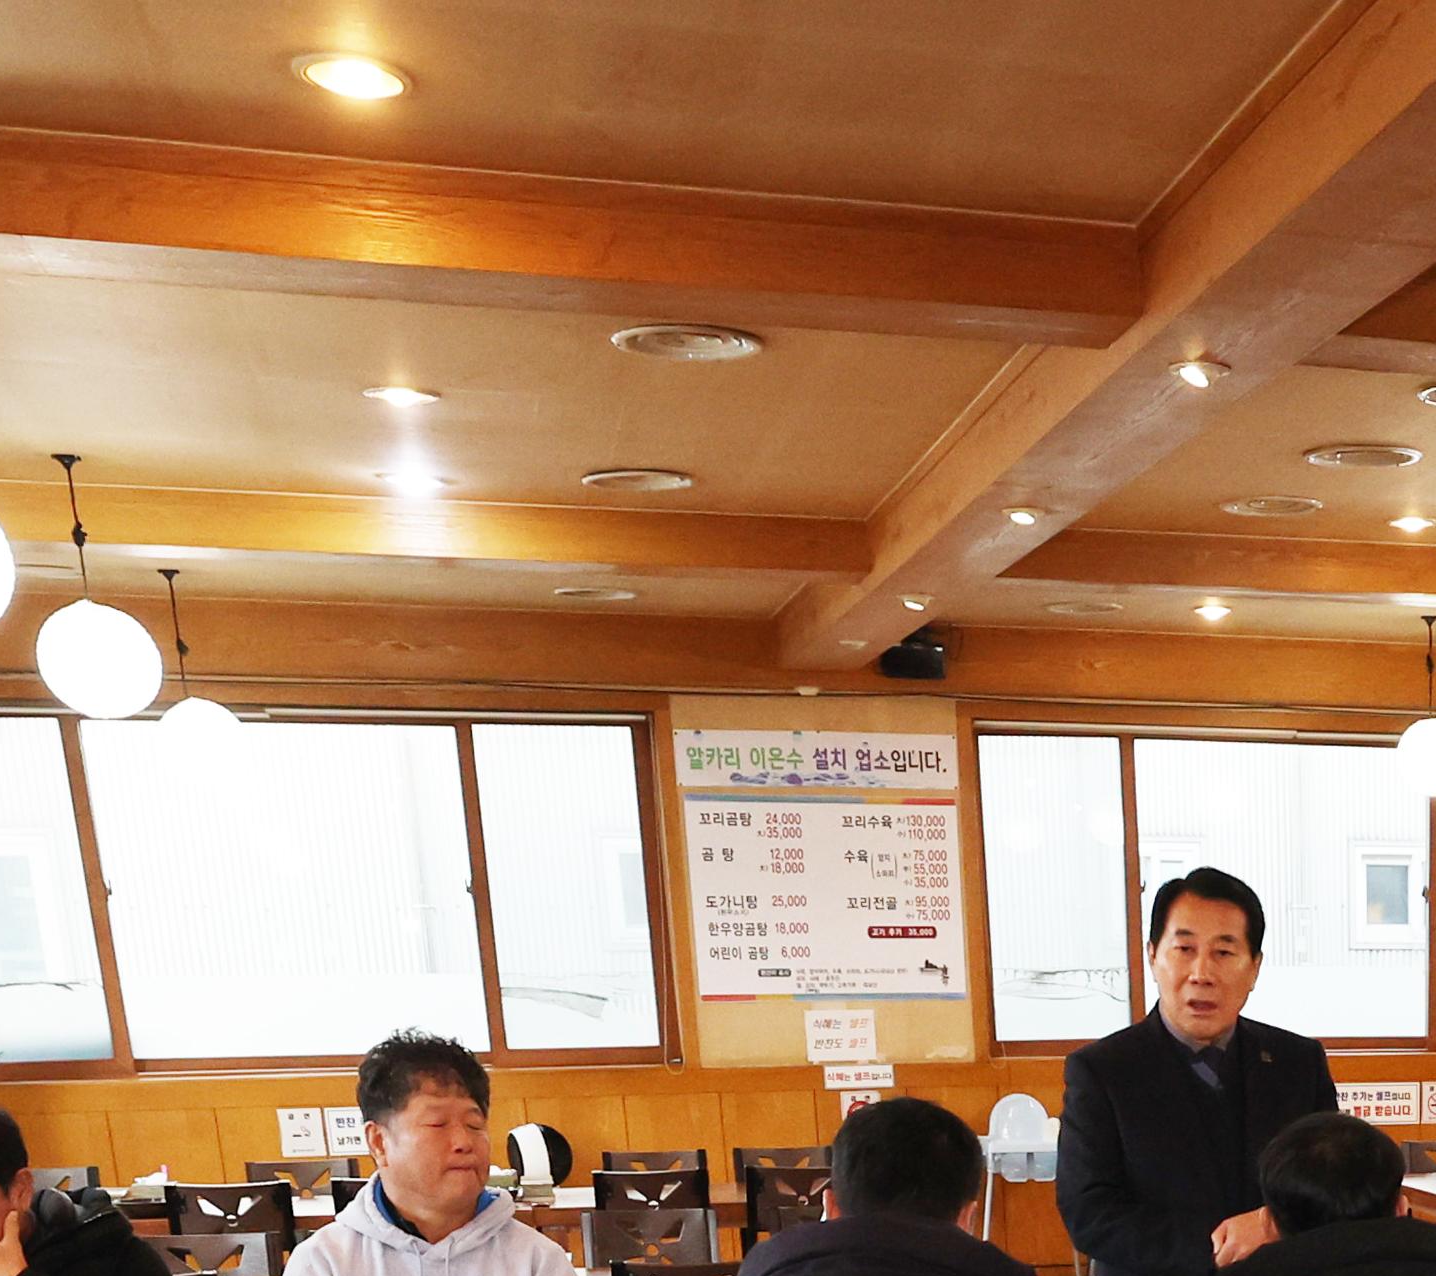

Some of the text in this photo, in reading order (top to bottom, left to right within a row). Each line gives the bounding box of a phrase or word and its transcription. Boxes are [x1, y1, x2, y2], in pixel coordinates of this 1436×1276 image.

[686, 746, 947, 773] 알카리 이온수 설치 업소입니다.
[699, 812, 802, 826] 꼬리곰탕 24,000
[842, 815, 893, 829] 꼬리수육
[908, 828, 947, 842] 110,000
[770, 848, 804, 861] 12,000
[844, 849, 869, 864] 수육
[913, 850, 948, 863] 75,000
[771, 862, 805, 875] 18,000
[913, 863, 948, 876] 55,000
[914, 876, 949, 889] 35,000
[706, 895, 807, 909] 도가니탕 25,000
[847, 896, 950, 910] 꼬리전골 95,000
[917, 909, 951, 922] 75,000
[708, 922, 809, 937] 한우양곰탕 18,000
[709, 945, 811, 961] 어린이 곰탕 6,000
